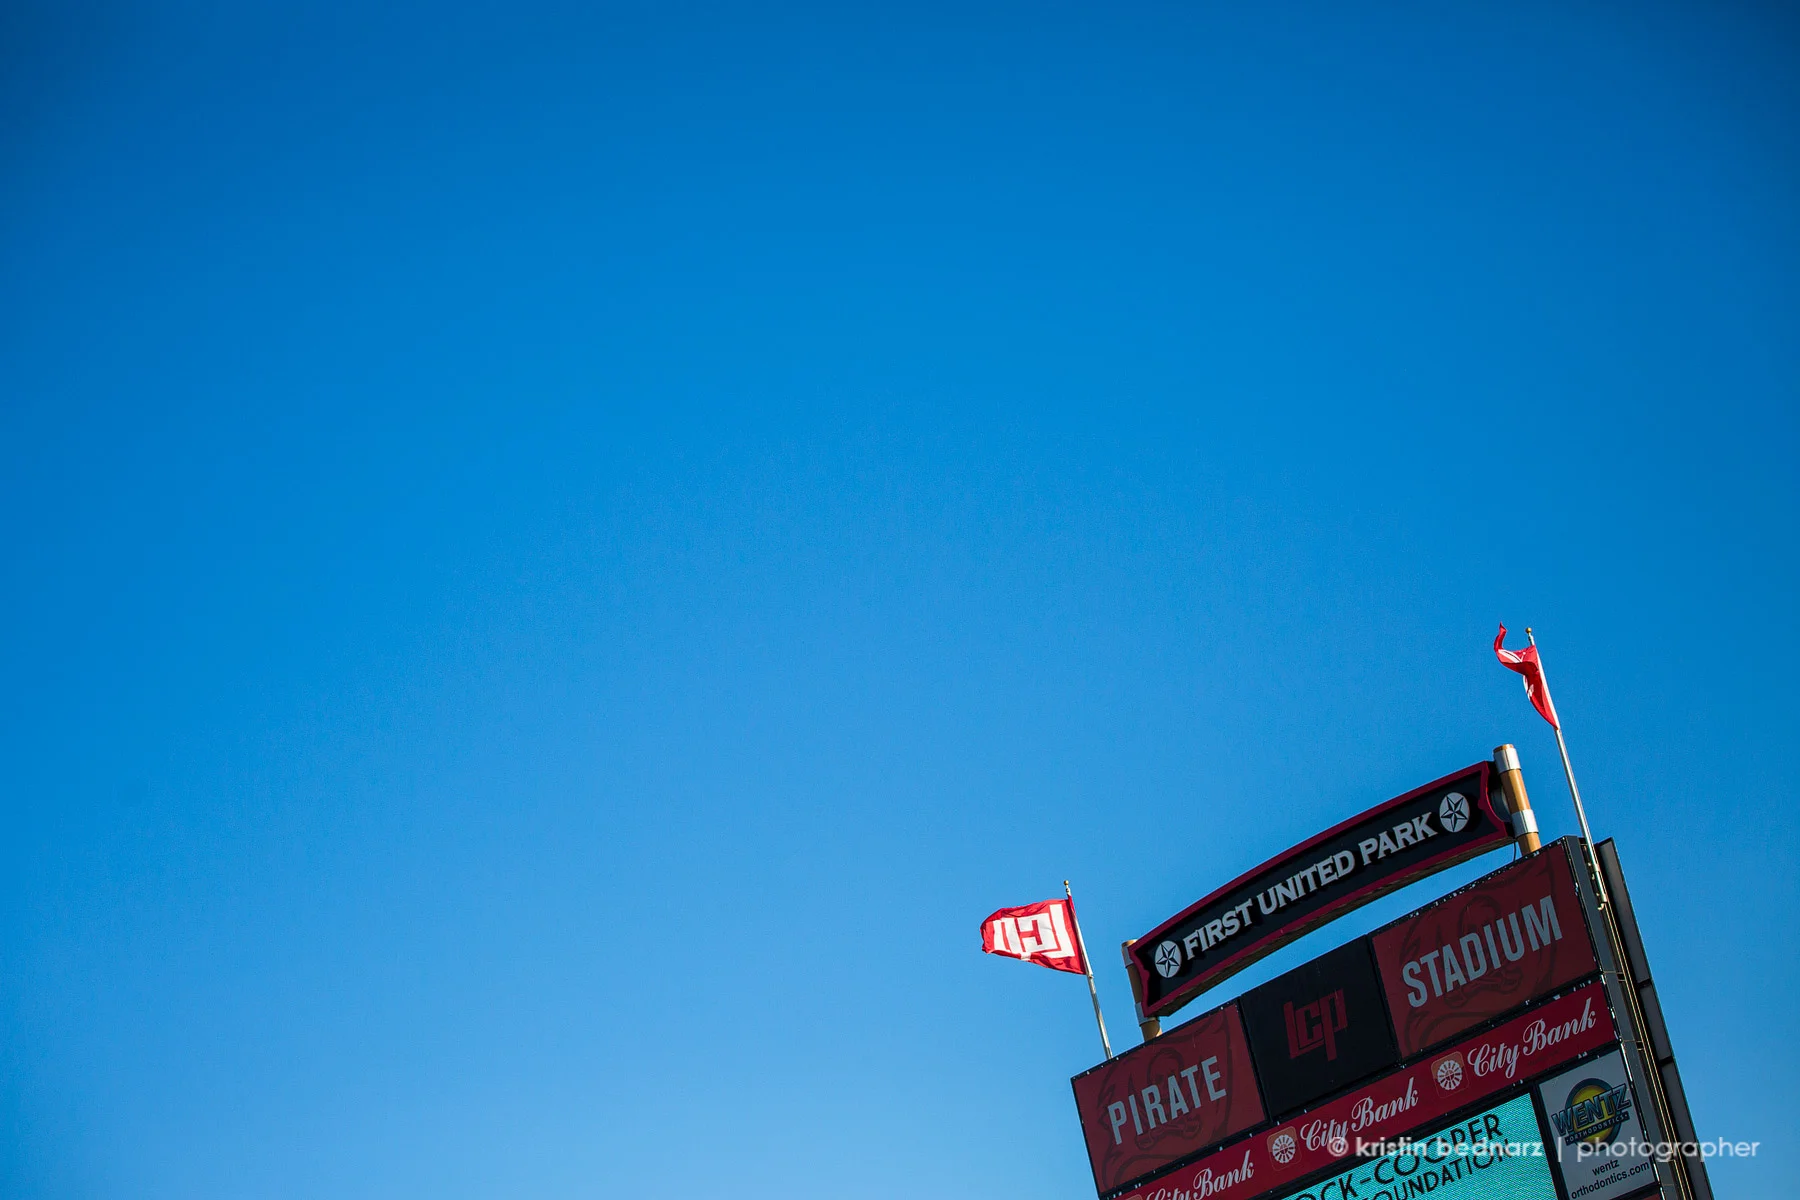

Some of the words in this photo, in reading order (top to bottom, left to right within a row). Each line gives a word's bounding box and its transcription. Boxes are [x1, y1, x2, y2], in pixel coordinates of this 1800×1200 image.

[1182, 898, 1254, 961] FIRST
[1257, 850, 1355, 915] UNITED
[1358, 811, 1438, 866] PARK
[1402, 895, 1563, 1008] STADIUM
[1467, 1043, 1521, 1079] City
[1522, 997, 1597, 1056] Bank
[1107, 1055, 1227, 1145] PIRATE
[1300, 1119, 1349, 1154] City
[1351, 1076, 1419, 1132] Bank
[1551, 1083, 1632, 1136] WENTZ
[1192, 1149, 1255, 1200] Bank
[1295, 1114, 1502, 1200] CK-COOPER
[1571, 1161, 1650, 1199] orthodontics.com
[1592, 1159, 1620, 1176] wentz
